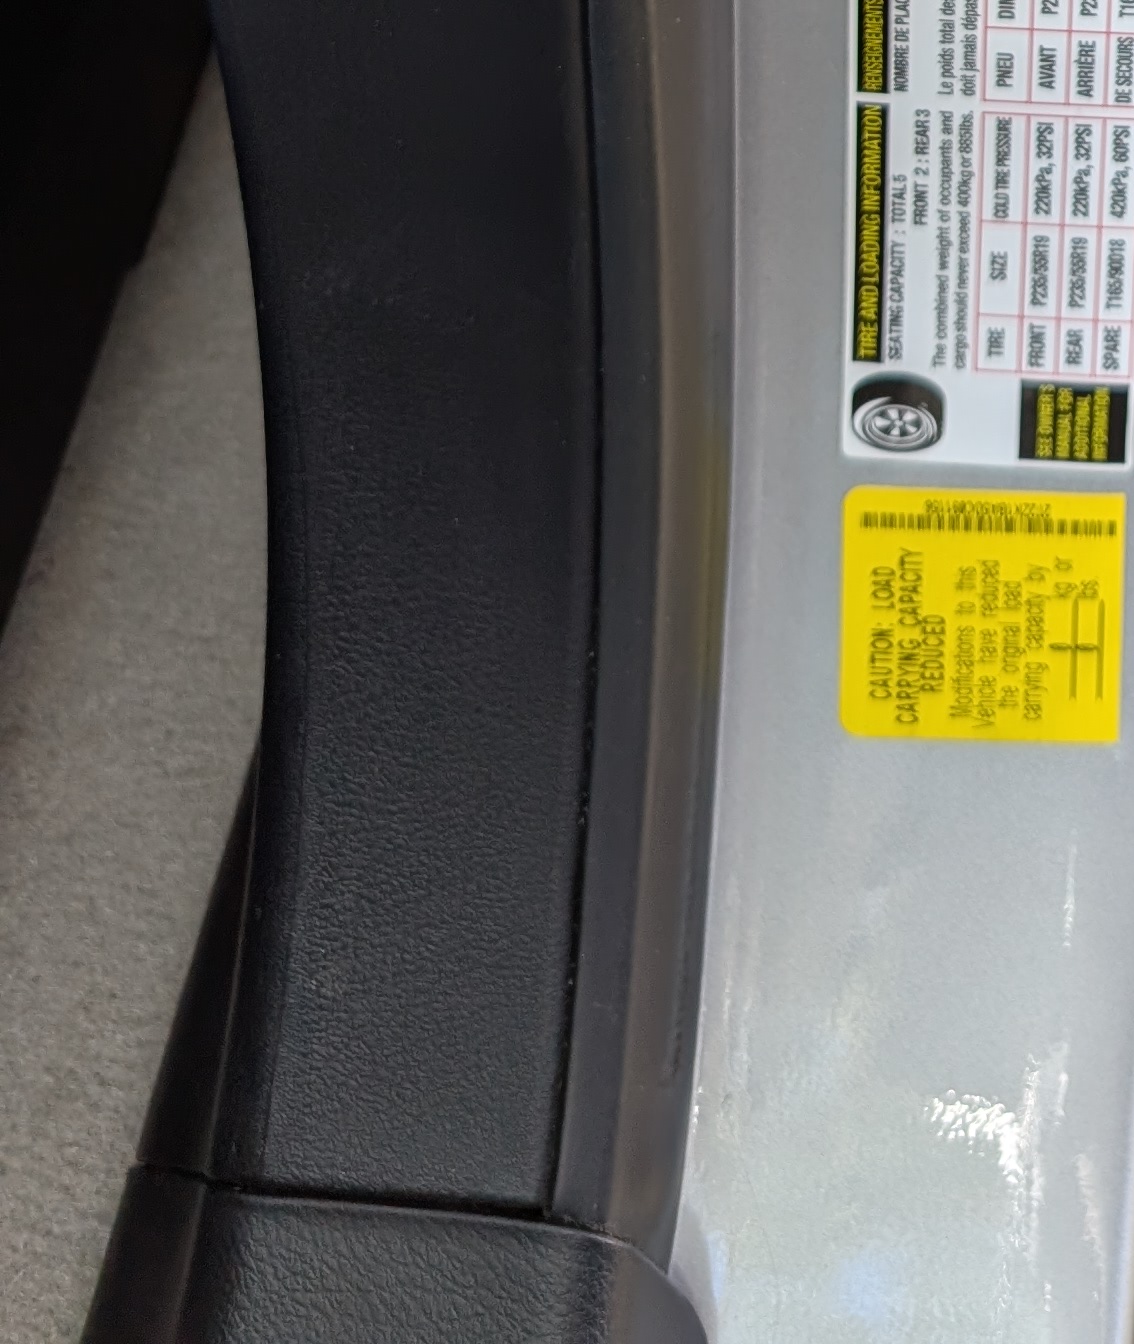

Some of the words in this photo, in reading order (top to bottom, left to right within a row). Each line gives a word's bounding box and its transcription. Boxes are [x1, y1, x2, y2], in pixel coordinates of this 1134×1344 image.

[997, 53, 1014, 87] PNEU
[1040, 45, 1057, 89] AVANT
[1077, 40, 1096, 98] ARRIÈRE
[1117, 36, 1134, 82] SECOURS
[1115, 85, 1132, 103] DE
[920, 615, 945, 693] REDUCED
